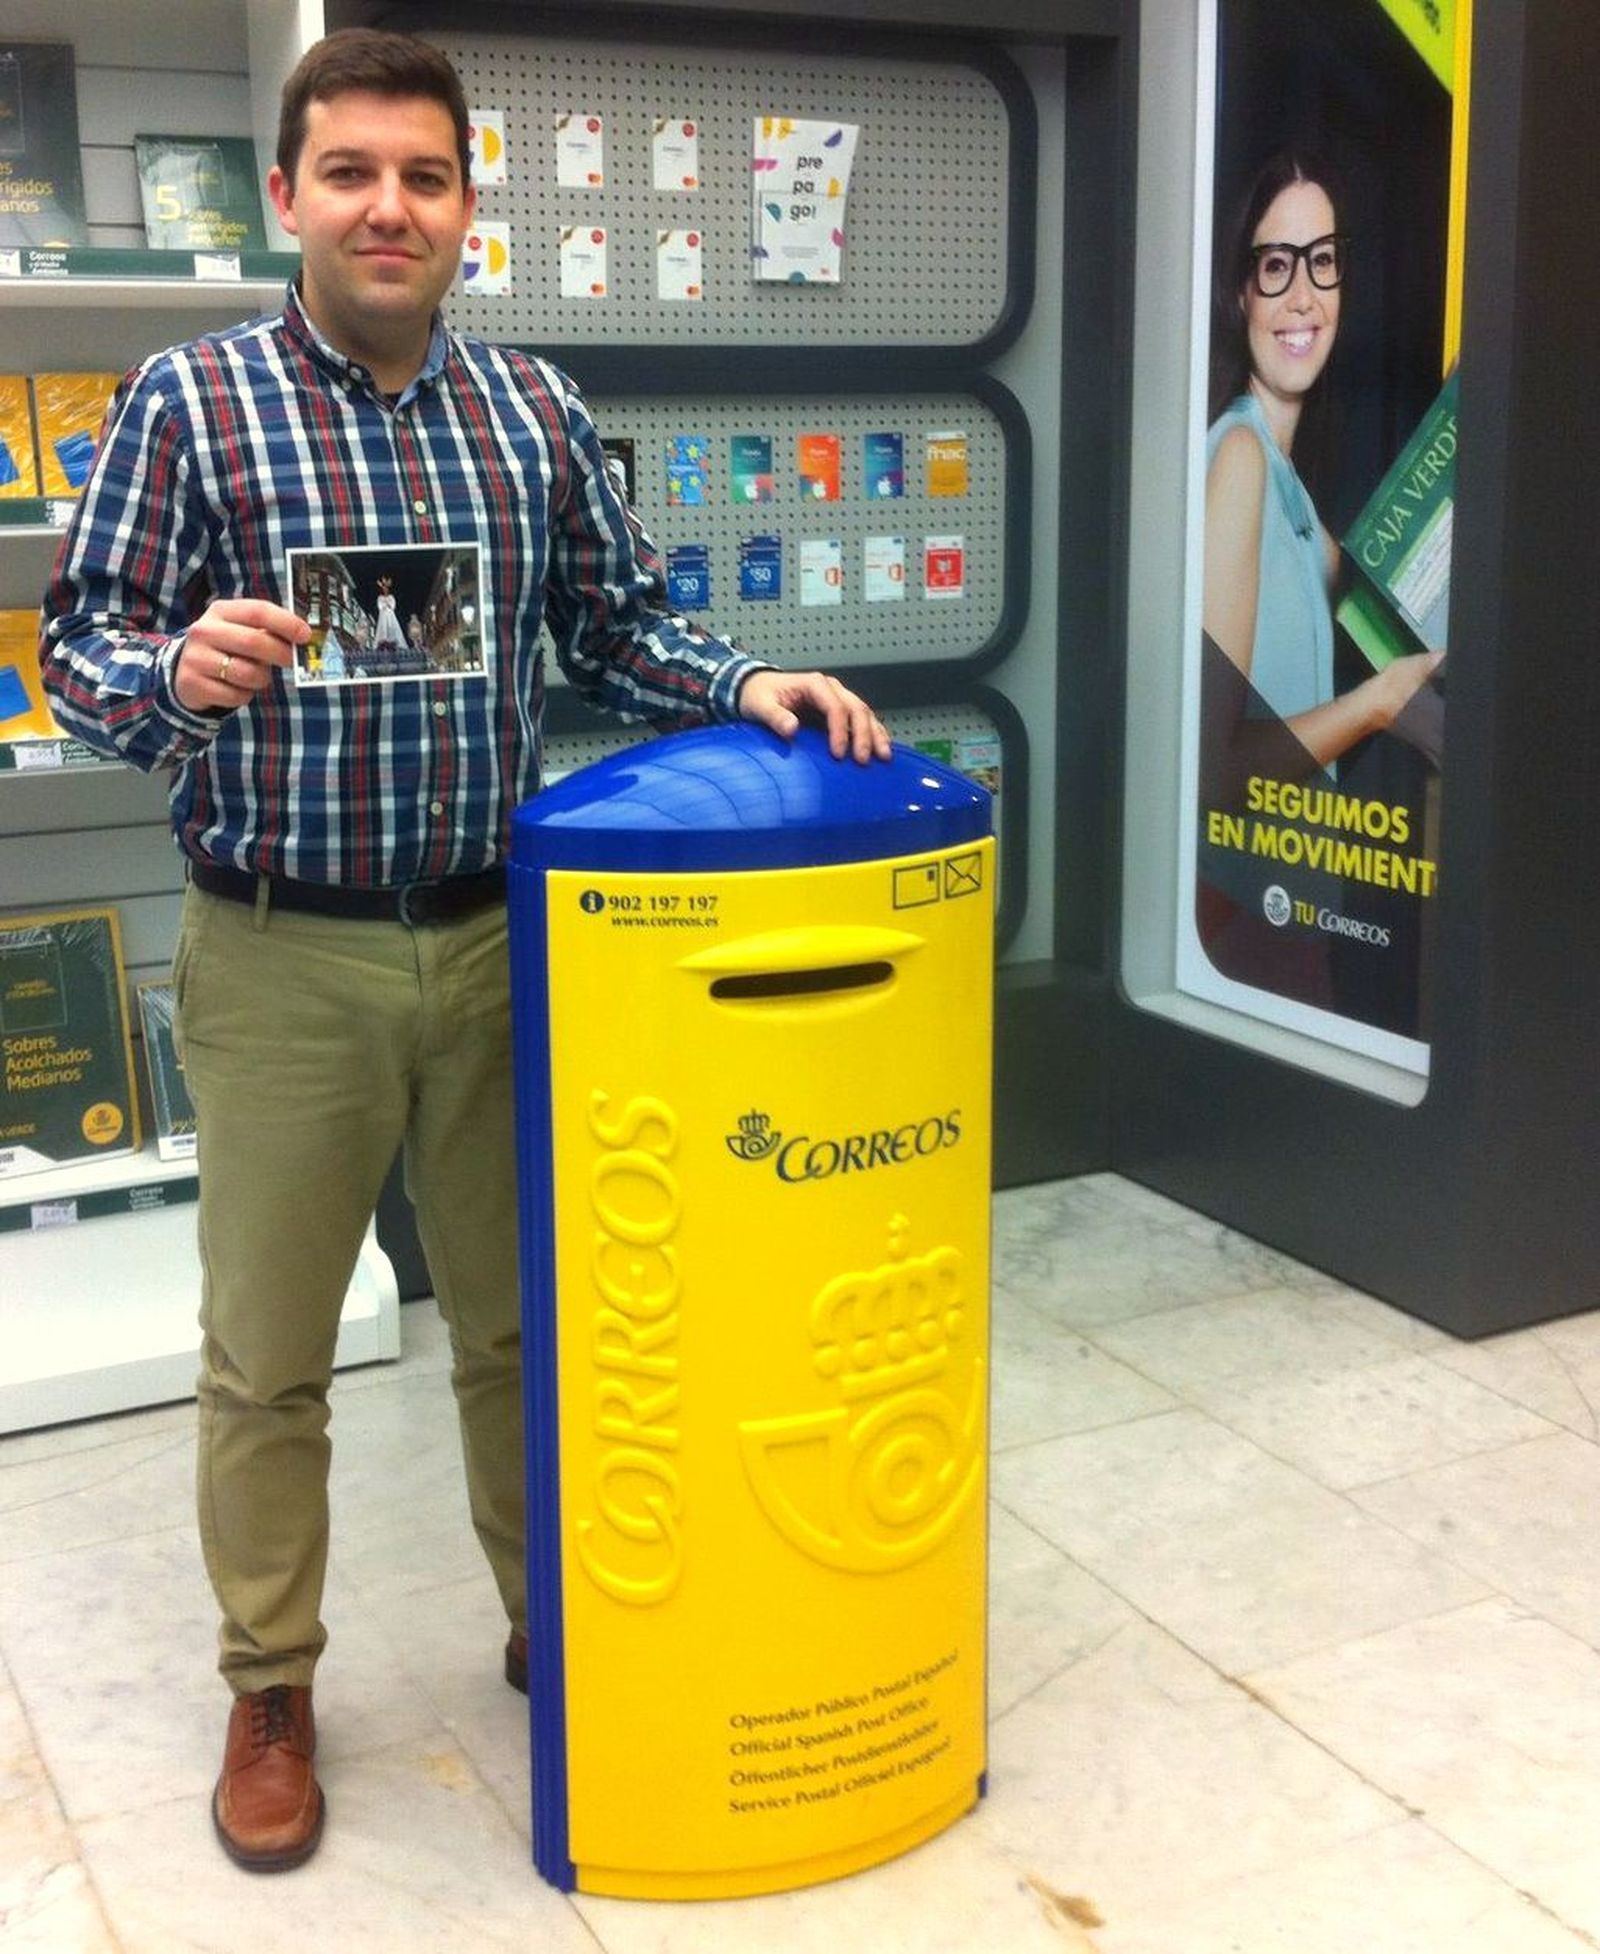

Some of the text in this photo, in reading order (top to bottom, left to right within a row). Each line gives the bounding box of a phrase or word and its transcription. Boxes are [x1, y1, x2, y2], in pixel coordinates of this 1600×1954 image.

[797, 156, 823, 171] pre
[793, 180, 815, 195] pa
[157, 185, 182, 220] 5
[790, 204, 817, 221] go!
[1363, 504, 1413, 588] CAJA
[1248, 776, 1410, 845] SEGUIMOS
[1208, 811, 1245, 850] EN
[608, 895, 718, 911] 902 197 197
[1295, 900, 1316, 926] TU
[611, 917, 719, 928] www.correos.es
[3, 1036, 57, 1056] Sobres
[7, 1047, 92, 1073] Acolchados
[8, 1066, 82, 1093] Medianos
[776, 1108, 962, 1184] CORREOS
[730, 1707, 811, 1733] Operador
[873, 1674, 911, 1700] Postal
[730, 1697, 929, 1756] Official Spanish Post Office
[728, 1797, 792, 1813] Service
[796, 1783, 840, 1805] Postal
